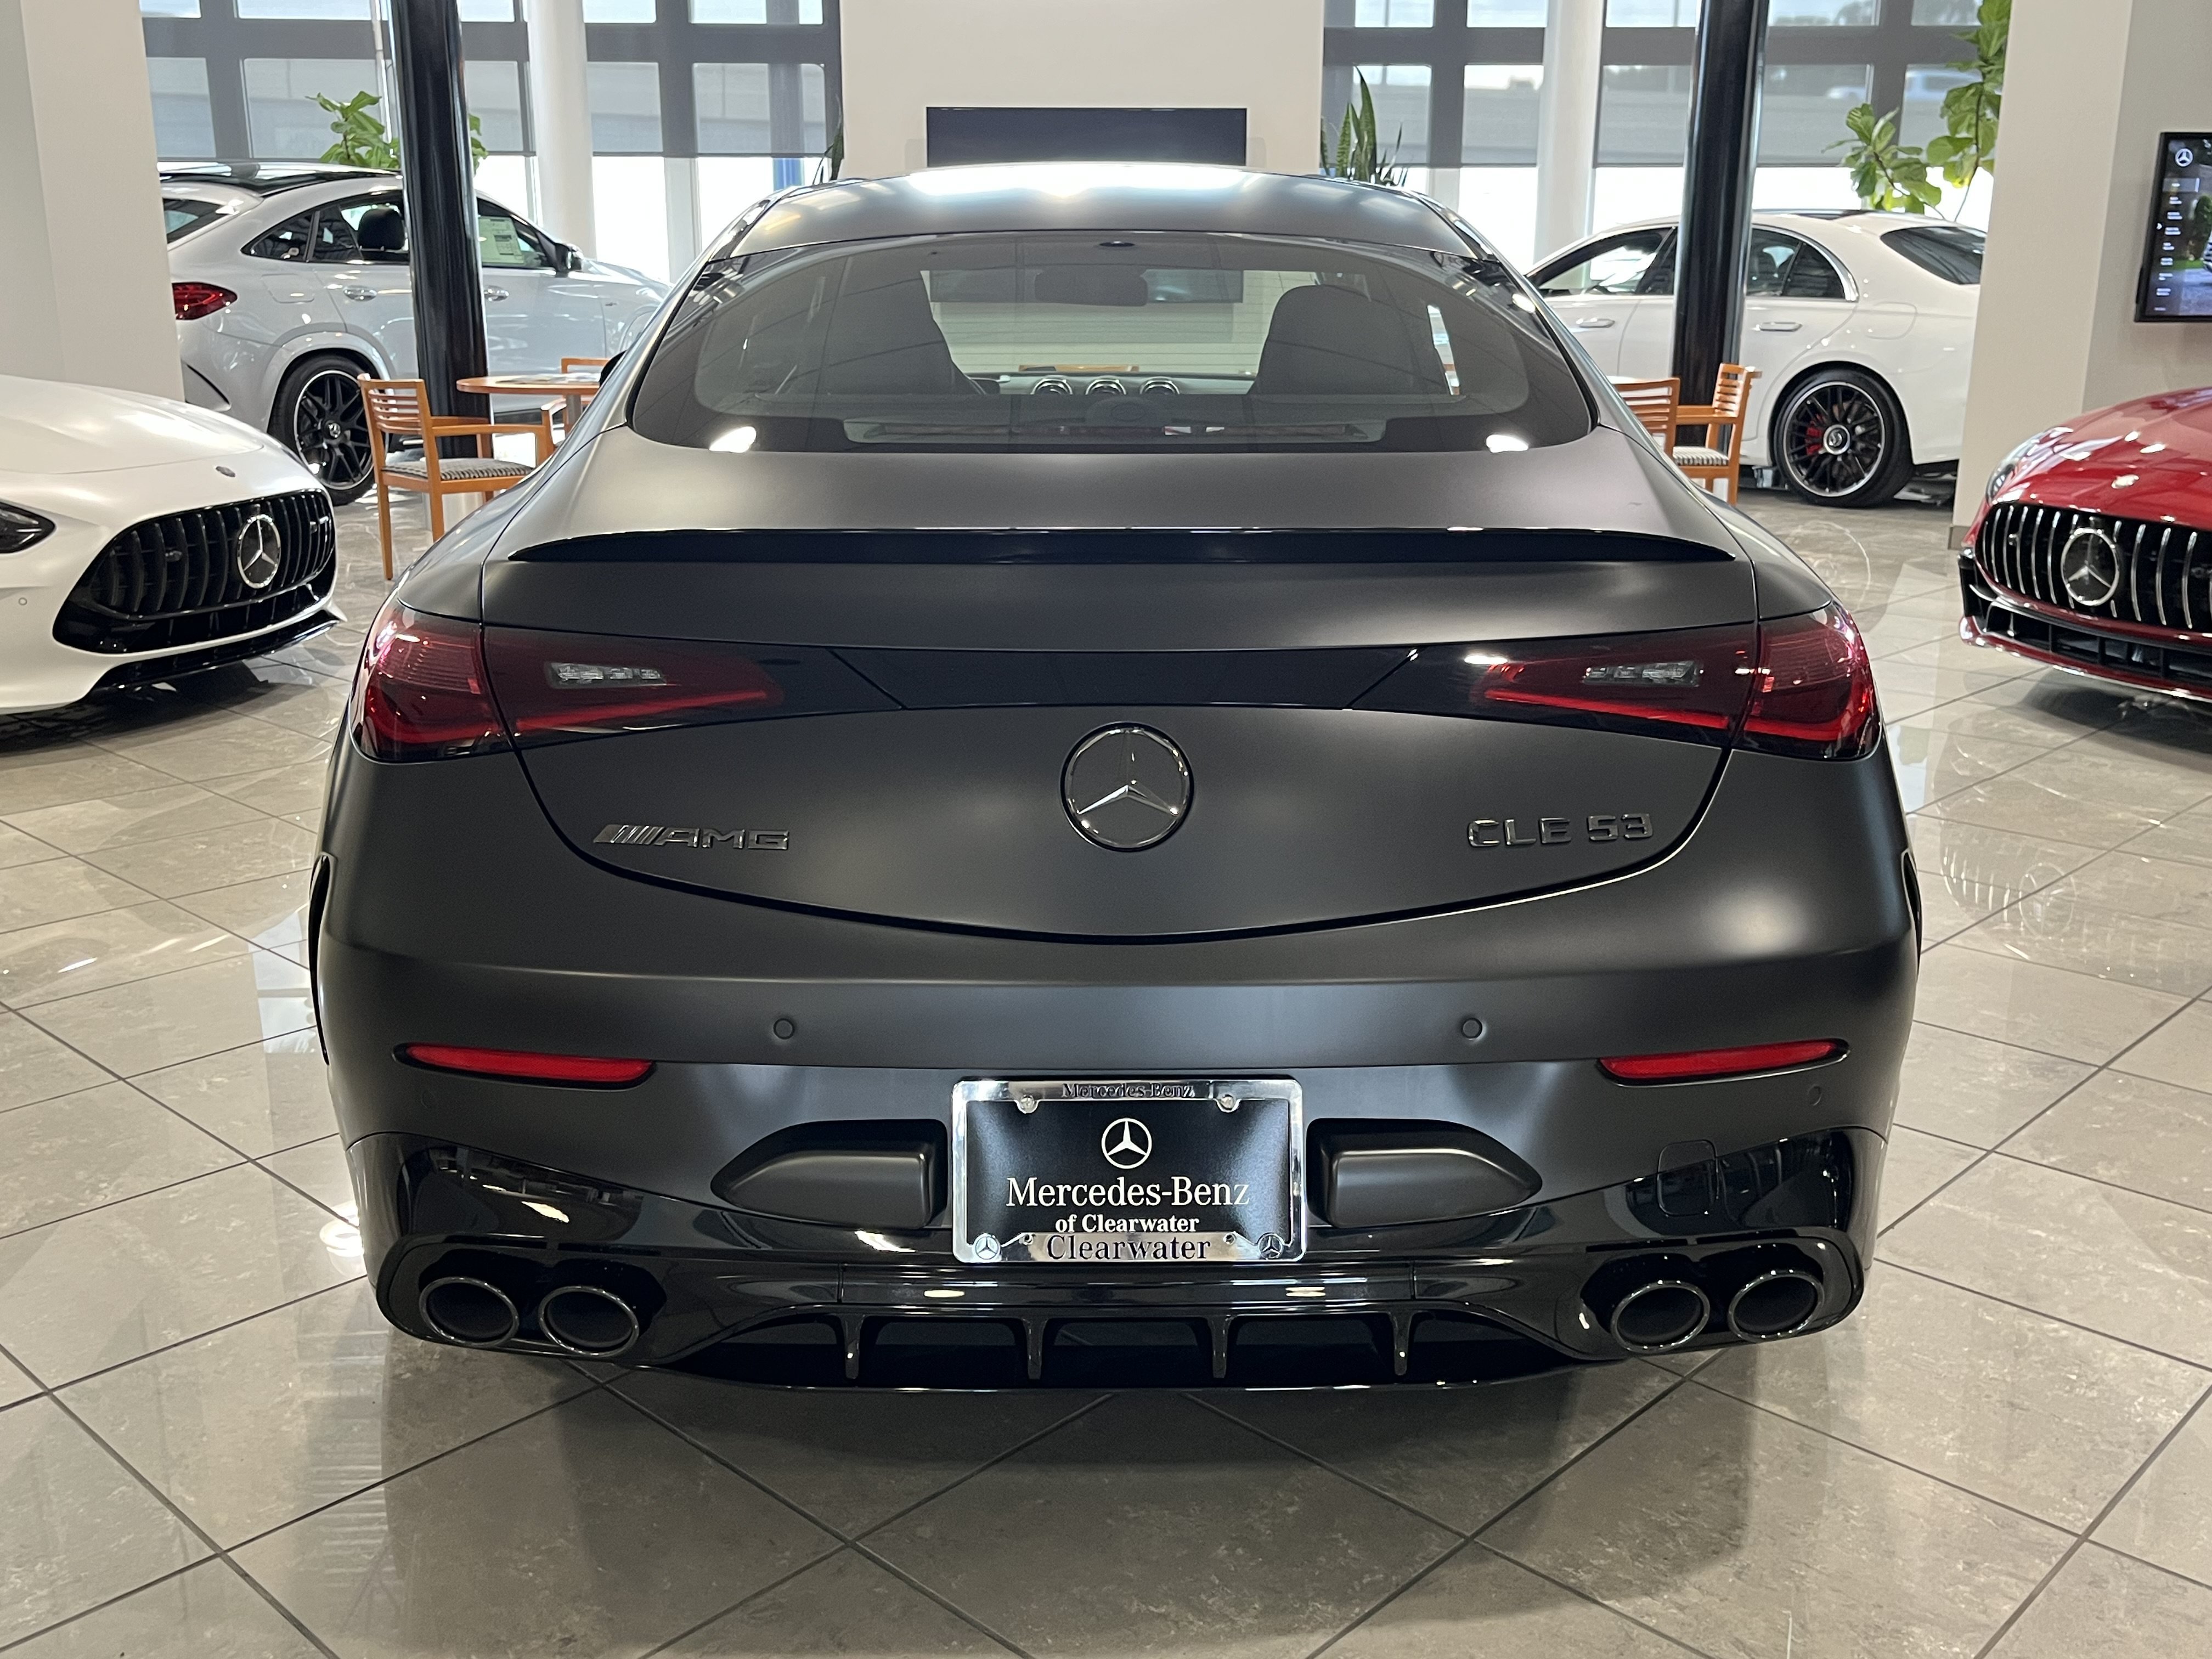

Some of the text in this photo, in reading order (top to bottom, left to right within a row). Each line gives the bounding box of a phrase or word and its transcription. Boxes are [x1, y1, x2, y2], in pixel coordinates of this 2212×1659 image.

[653, 826, 789, 850] AMG
[1468, 813, 1653, 848] CLE 53
[1062, 1082, 1195, 1098] Mercedes-Benz
[1006, 1176, 1250, 1207] Mercedes-Benz
[1055, 1214, 1200, 1233] of Clearwater
[1046, 1234, 1211, 1261] Clearwater
